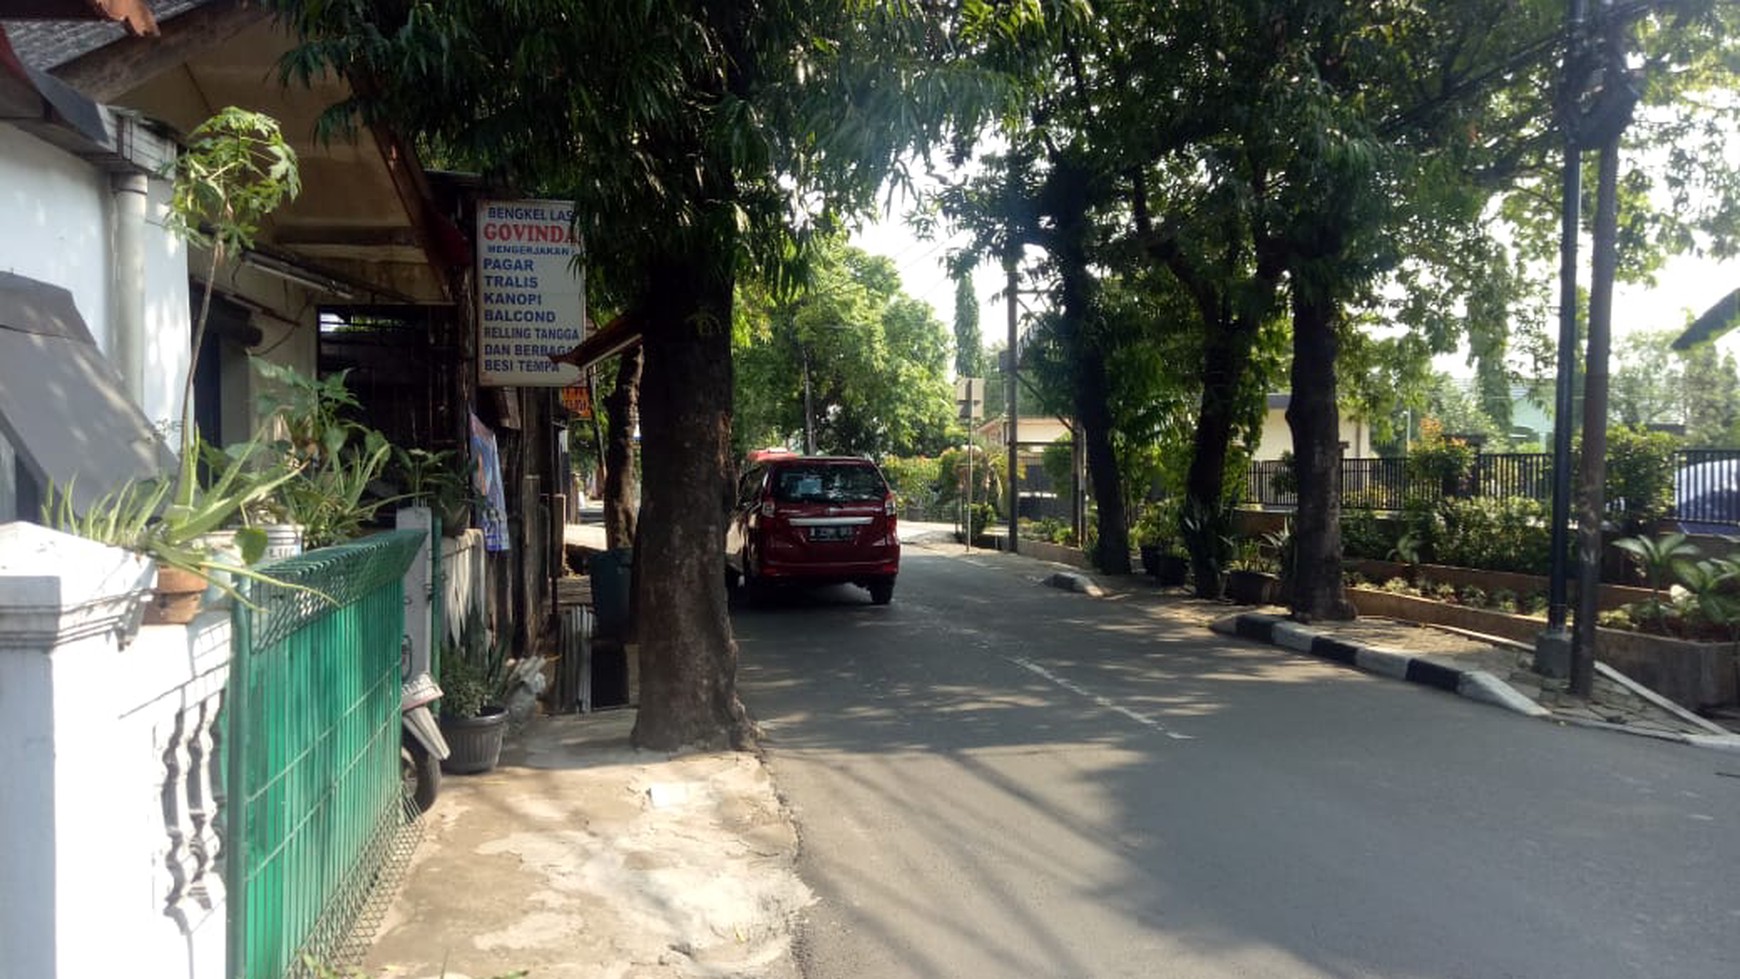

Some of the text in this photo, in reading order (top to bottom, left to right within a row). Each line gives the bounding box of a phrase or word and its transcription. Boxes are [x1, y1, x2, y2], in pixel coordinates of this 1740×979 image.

[488, 207, 576, 222] BENGKEL LAS
[483, 222, 578, 244] GOVINDA
[483, 258, 534, 271] PAGAR
[484, 275, 538, 288] TRALIS
[484, 292, 542, 306] KANOPI
[484, 309, 556, 322] BALCOND
[484, 326, 580, 340] RELLING TANGGA
[484, 344, 510, 355] DAN
[484, 359, 513, 371] BESI
